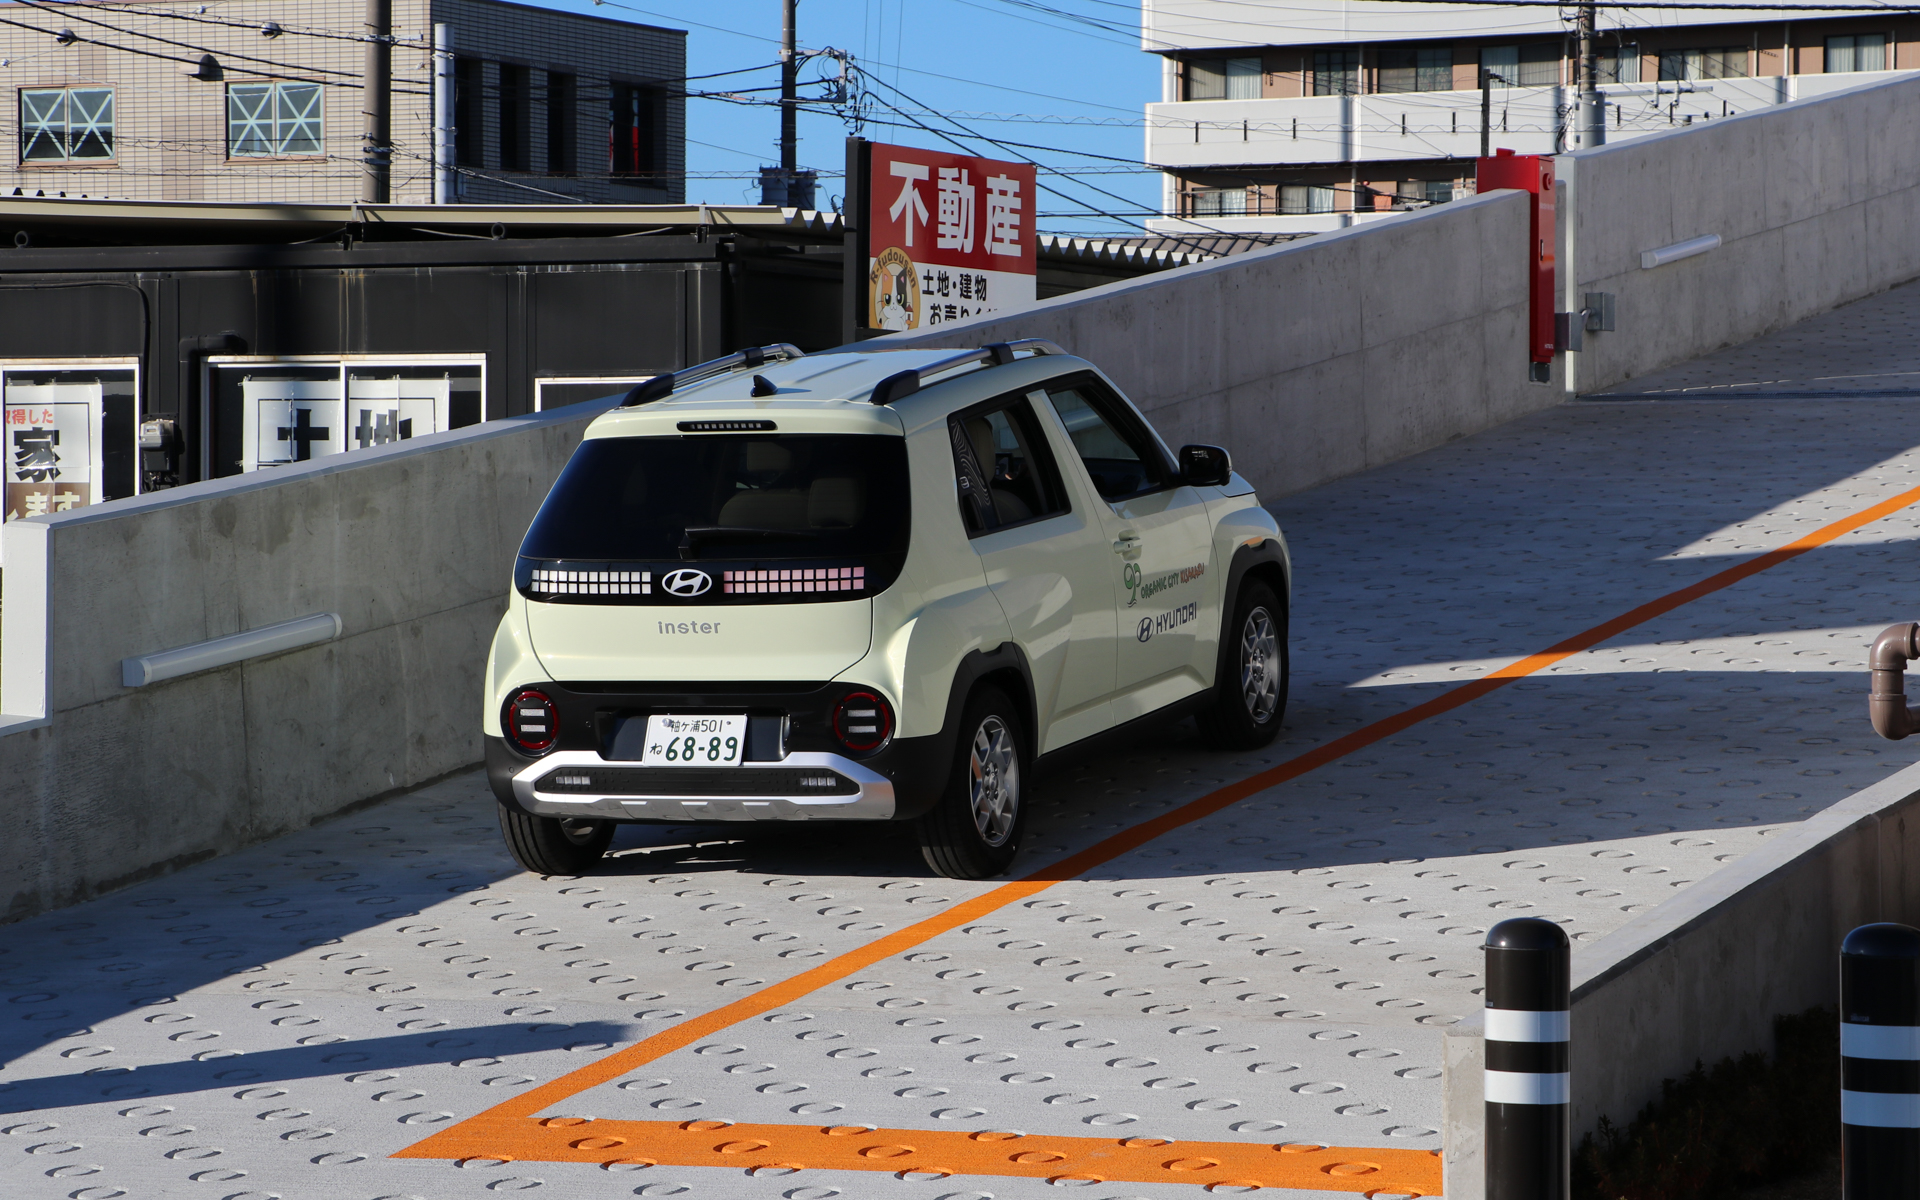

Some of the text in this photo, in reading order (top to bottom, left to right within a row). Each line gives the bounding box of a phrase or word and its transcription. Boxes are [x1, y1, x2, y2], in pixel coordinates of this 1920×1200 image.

[889, 160, 1022, 257] 不動産
[870, 249, 917, 288] R-fudousan
[14, 427, 62, 483] 家
[1140, 576, 1167, 599] ORGANIC
[1167, 572, 1180, 588] CITY
[1156, 601, 1197, 634] HYUNDAI
[649, 736, 738, 761] ね 68-89
